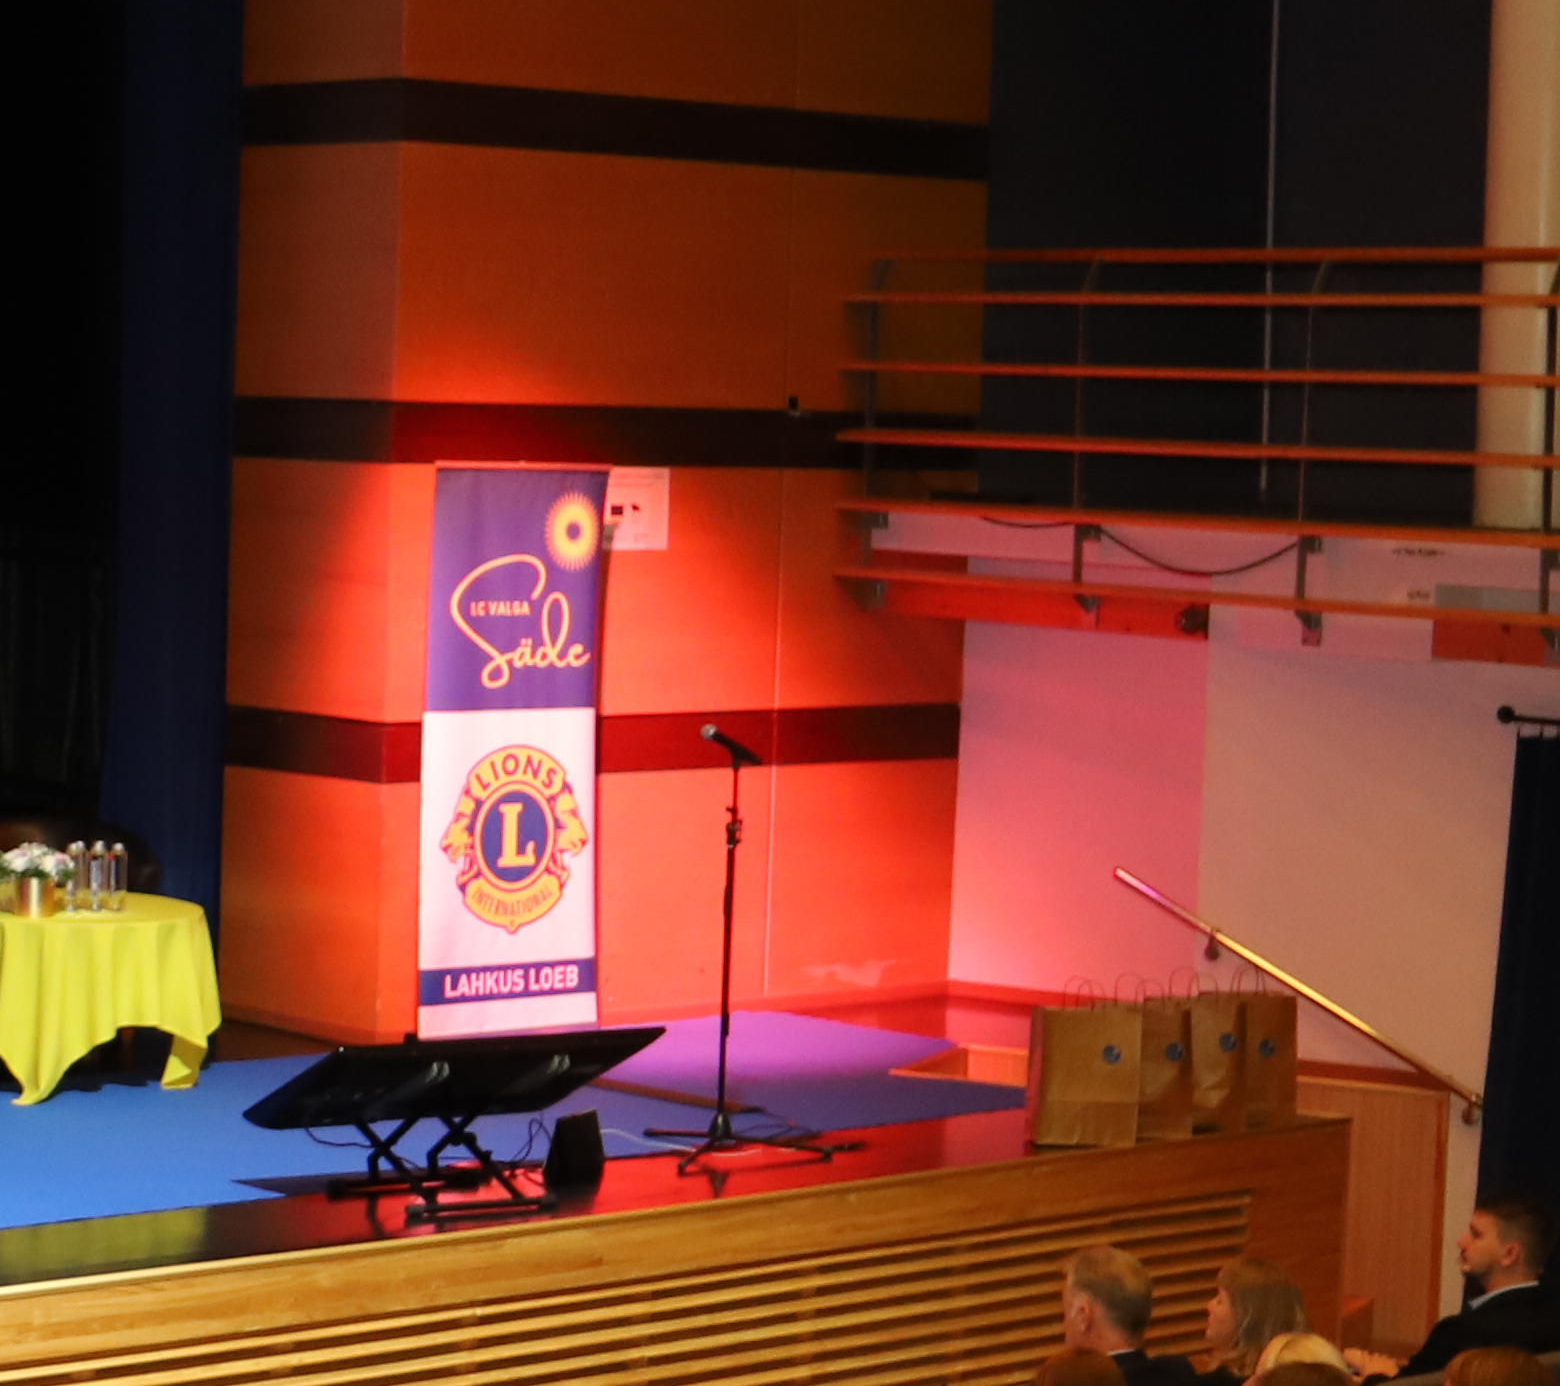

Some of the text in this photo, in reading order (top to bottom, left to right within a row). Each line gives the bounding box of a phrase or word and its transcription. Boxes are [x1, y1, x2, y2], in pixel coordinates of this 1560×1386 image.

[488, 599, 532, 617] VALGA
[474, 752, 558, 791] LIONS
[497, 801, 537, 868] L
[470, 885, 554, 916] INTERNATIONAL
[444, 963, 580, 998] LAHKUS LOEB
